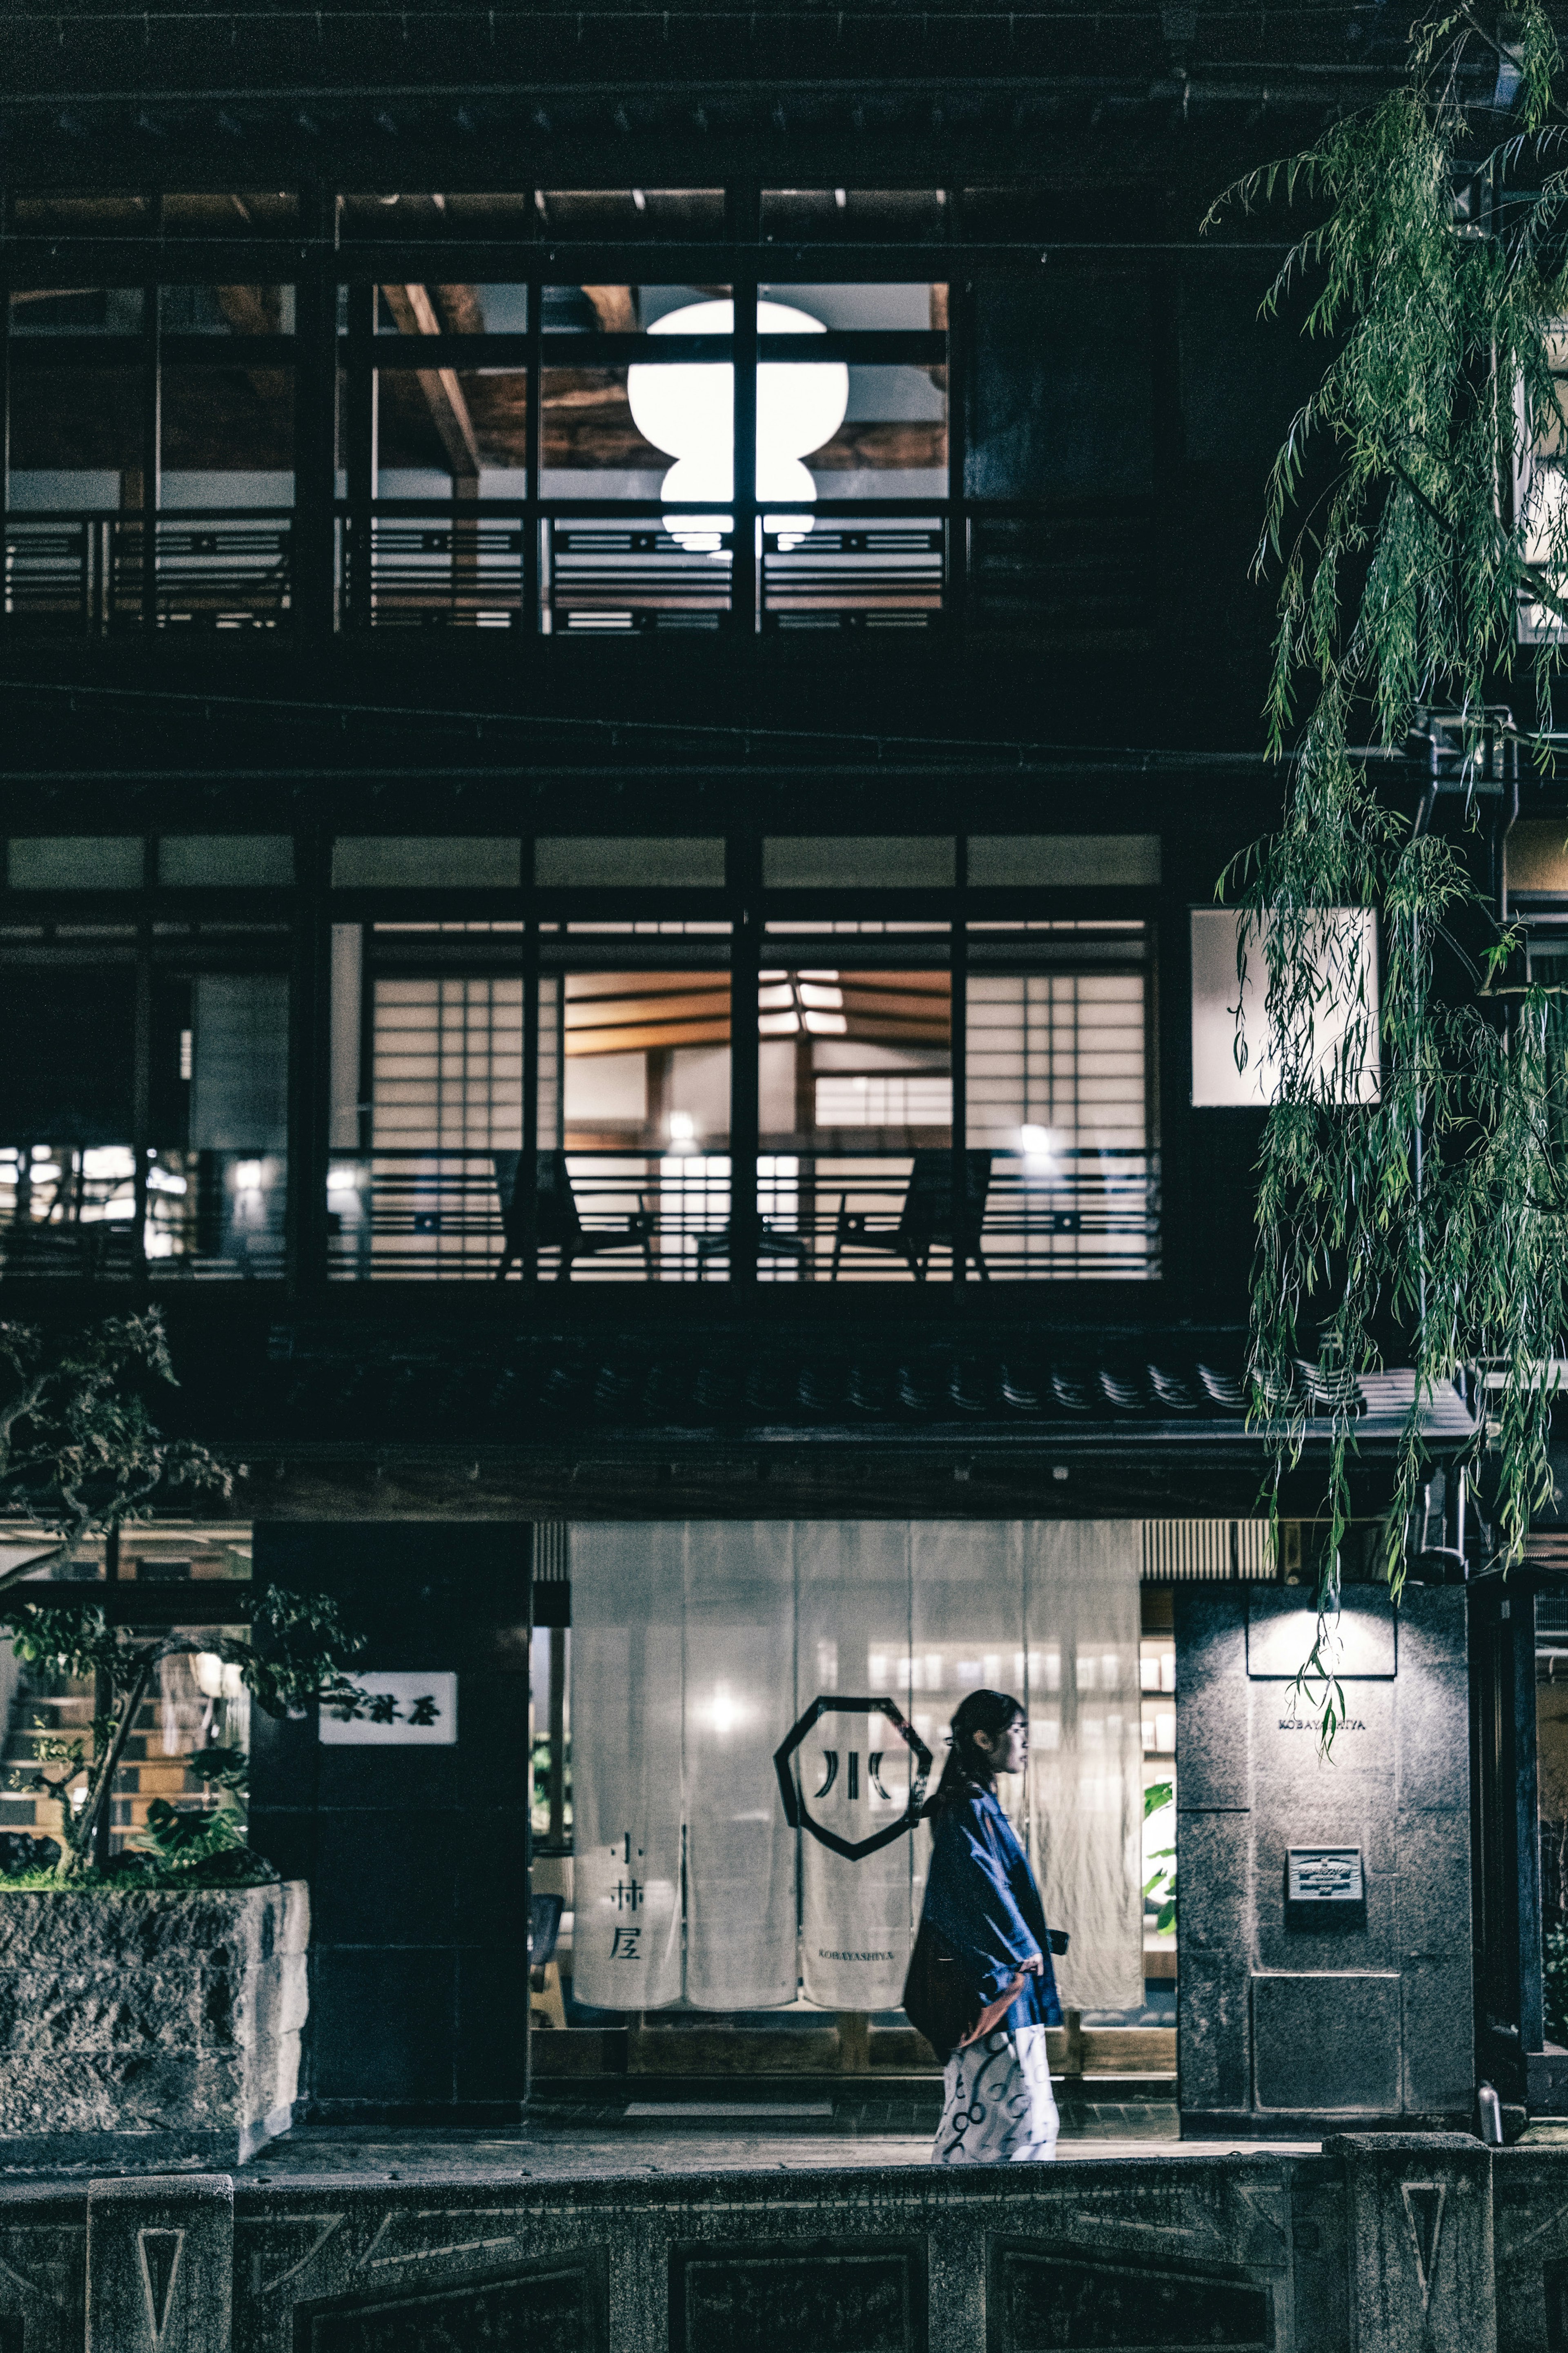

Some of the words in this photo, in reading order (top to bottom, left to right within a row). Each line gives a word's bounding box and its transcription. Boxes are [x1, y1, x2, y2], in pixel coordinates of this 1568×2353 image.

[609, 1832, 644, 1960] 小林屋
[819, 1949, 895, 1961] KOBAYASHIYA
